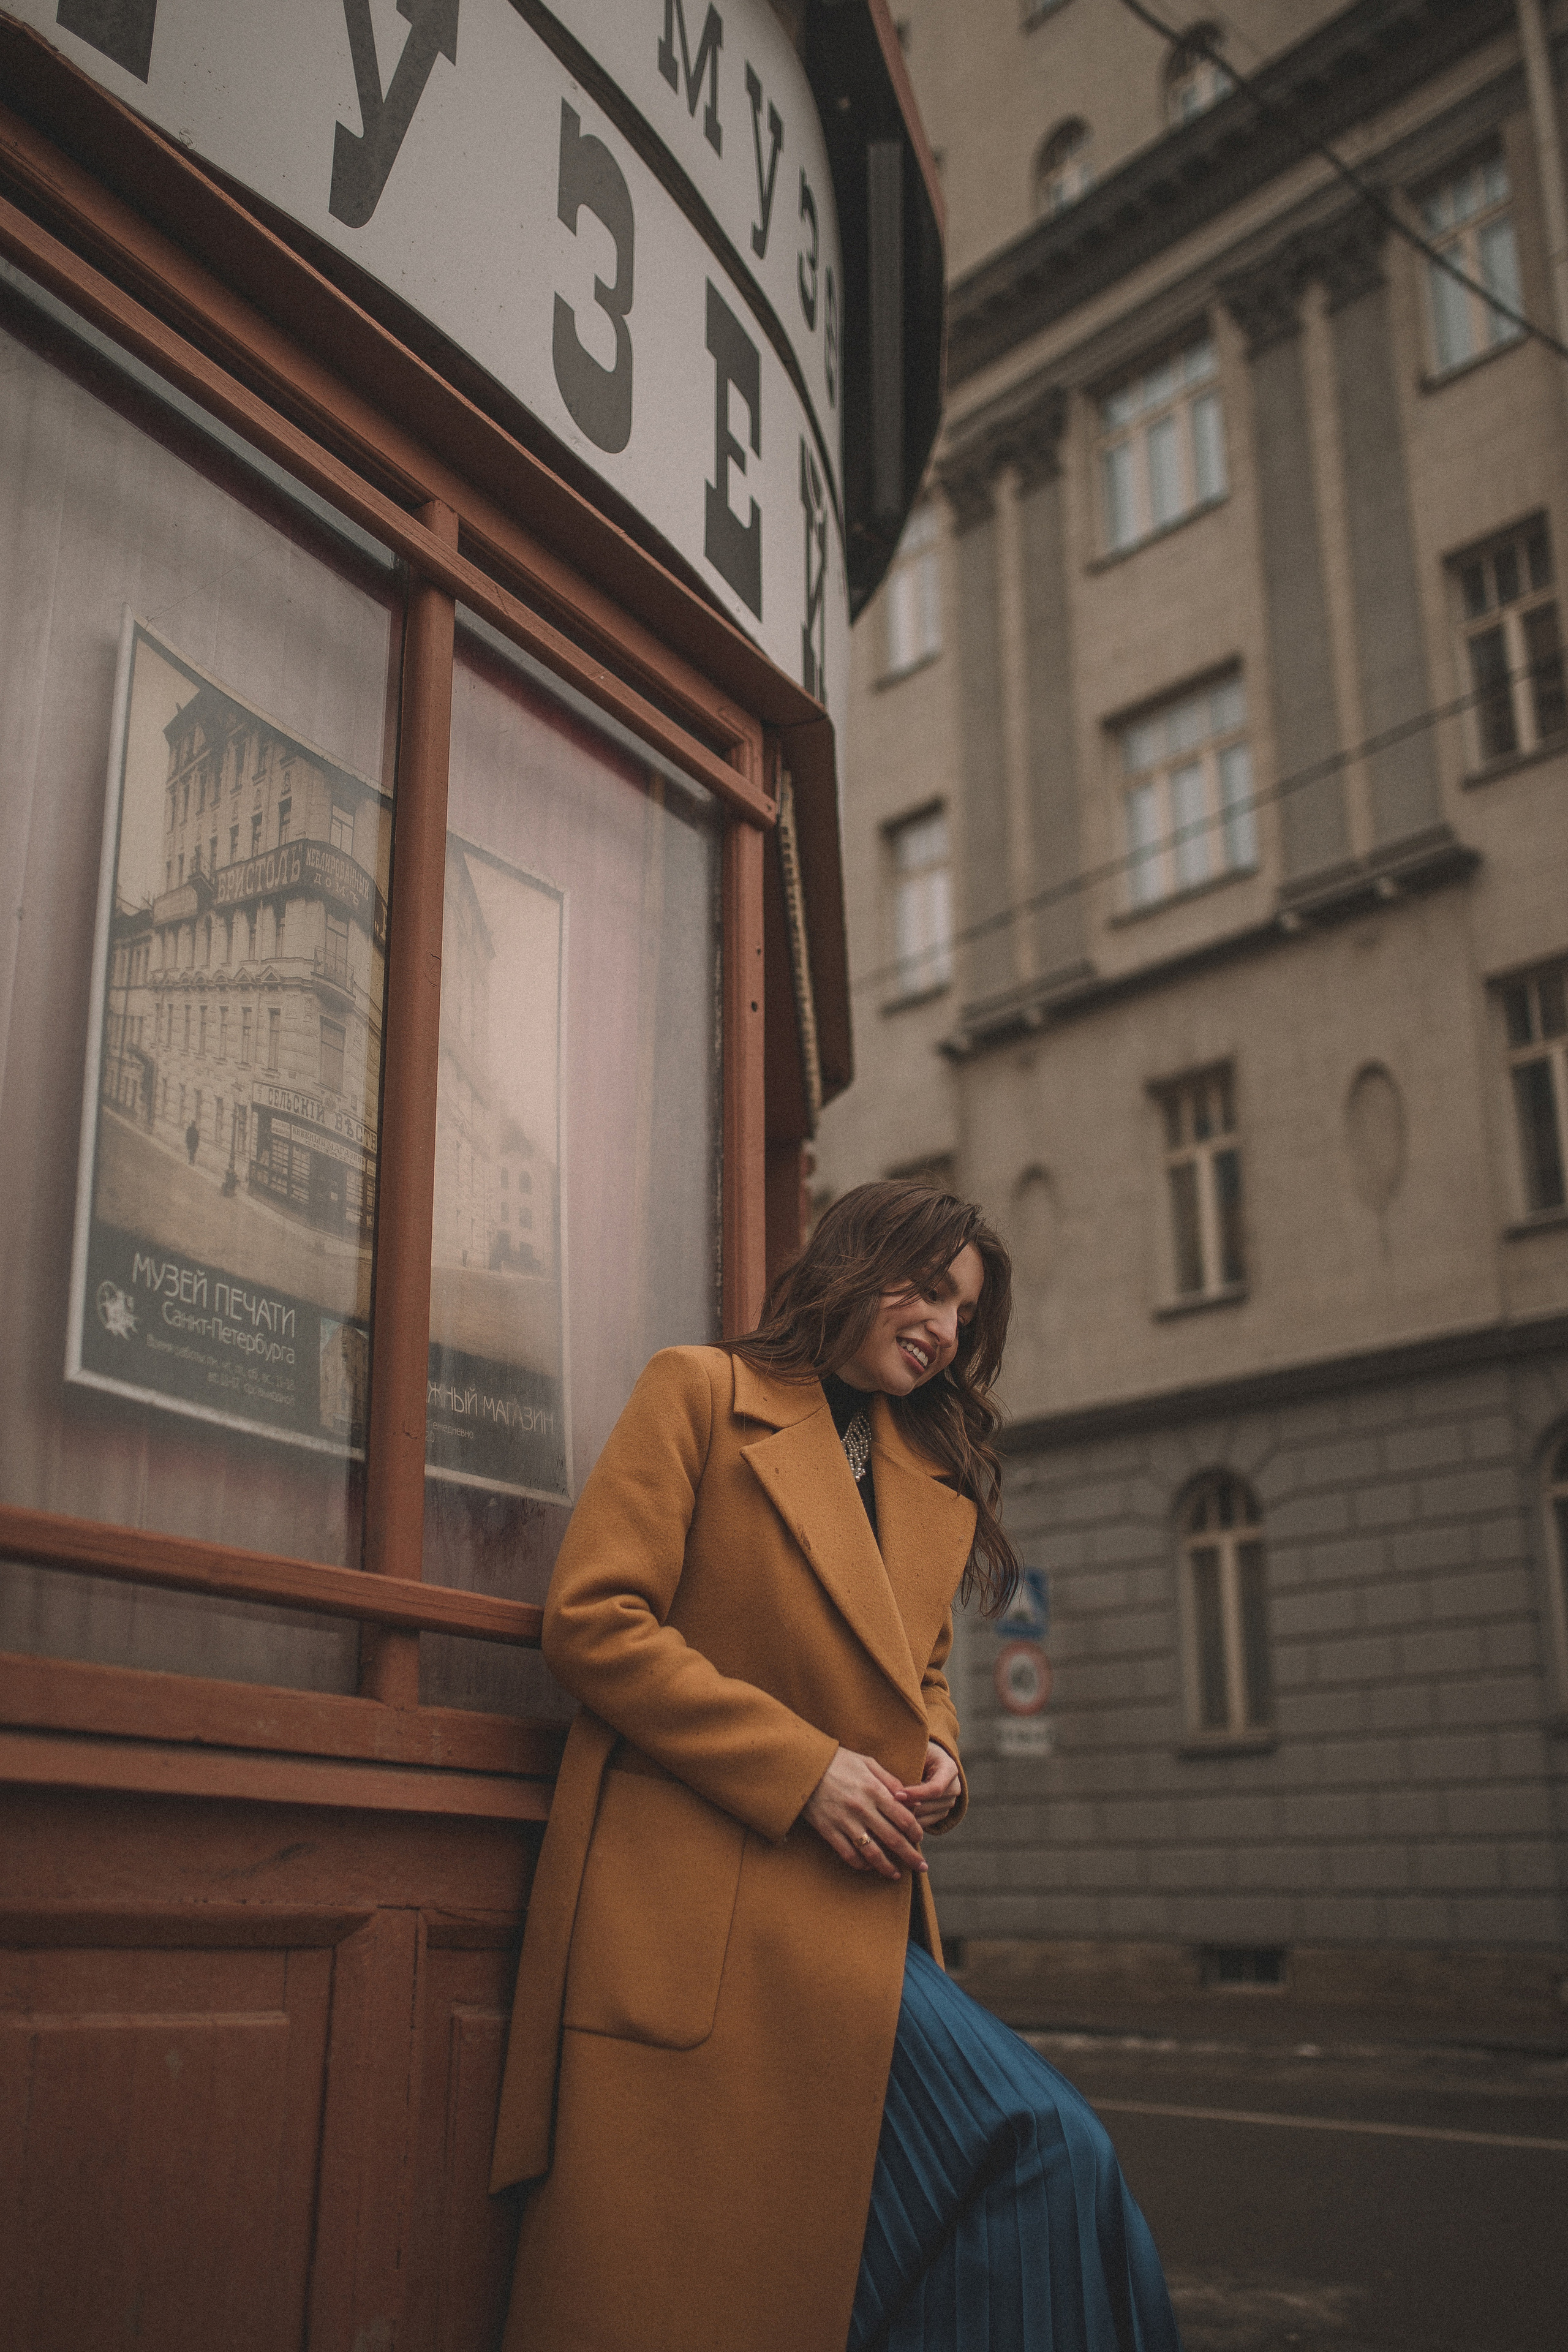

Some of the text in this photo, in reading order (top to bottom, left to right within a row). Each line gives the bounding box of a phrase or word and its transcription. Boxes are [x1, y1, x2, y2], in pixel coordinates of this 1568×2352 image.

[56, 0, 828, 712] УЗЕЙ
[132, 1252, 295, 1338] МУЗЕЙ ПЕЧАТИ
[162, 1301, 295, 1365] Санкт-Петербурга
[426, 1380, 554, 1435] ЖНЫЙ МАГАЗИН
